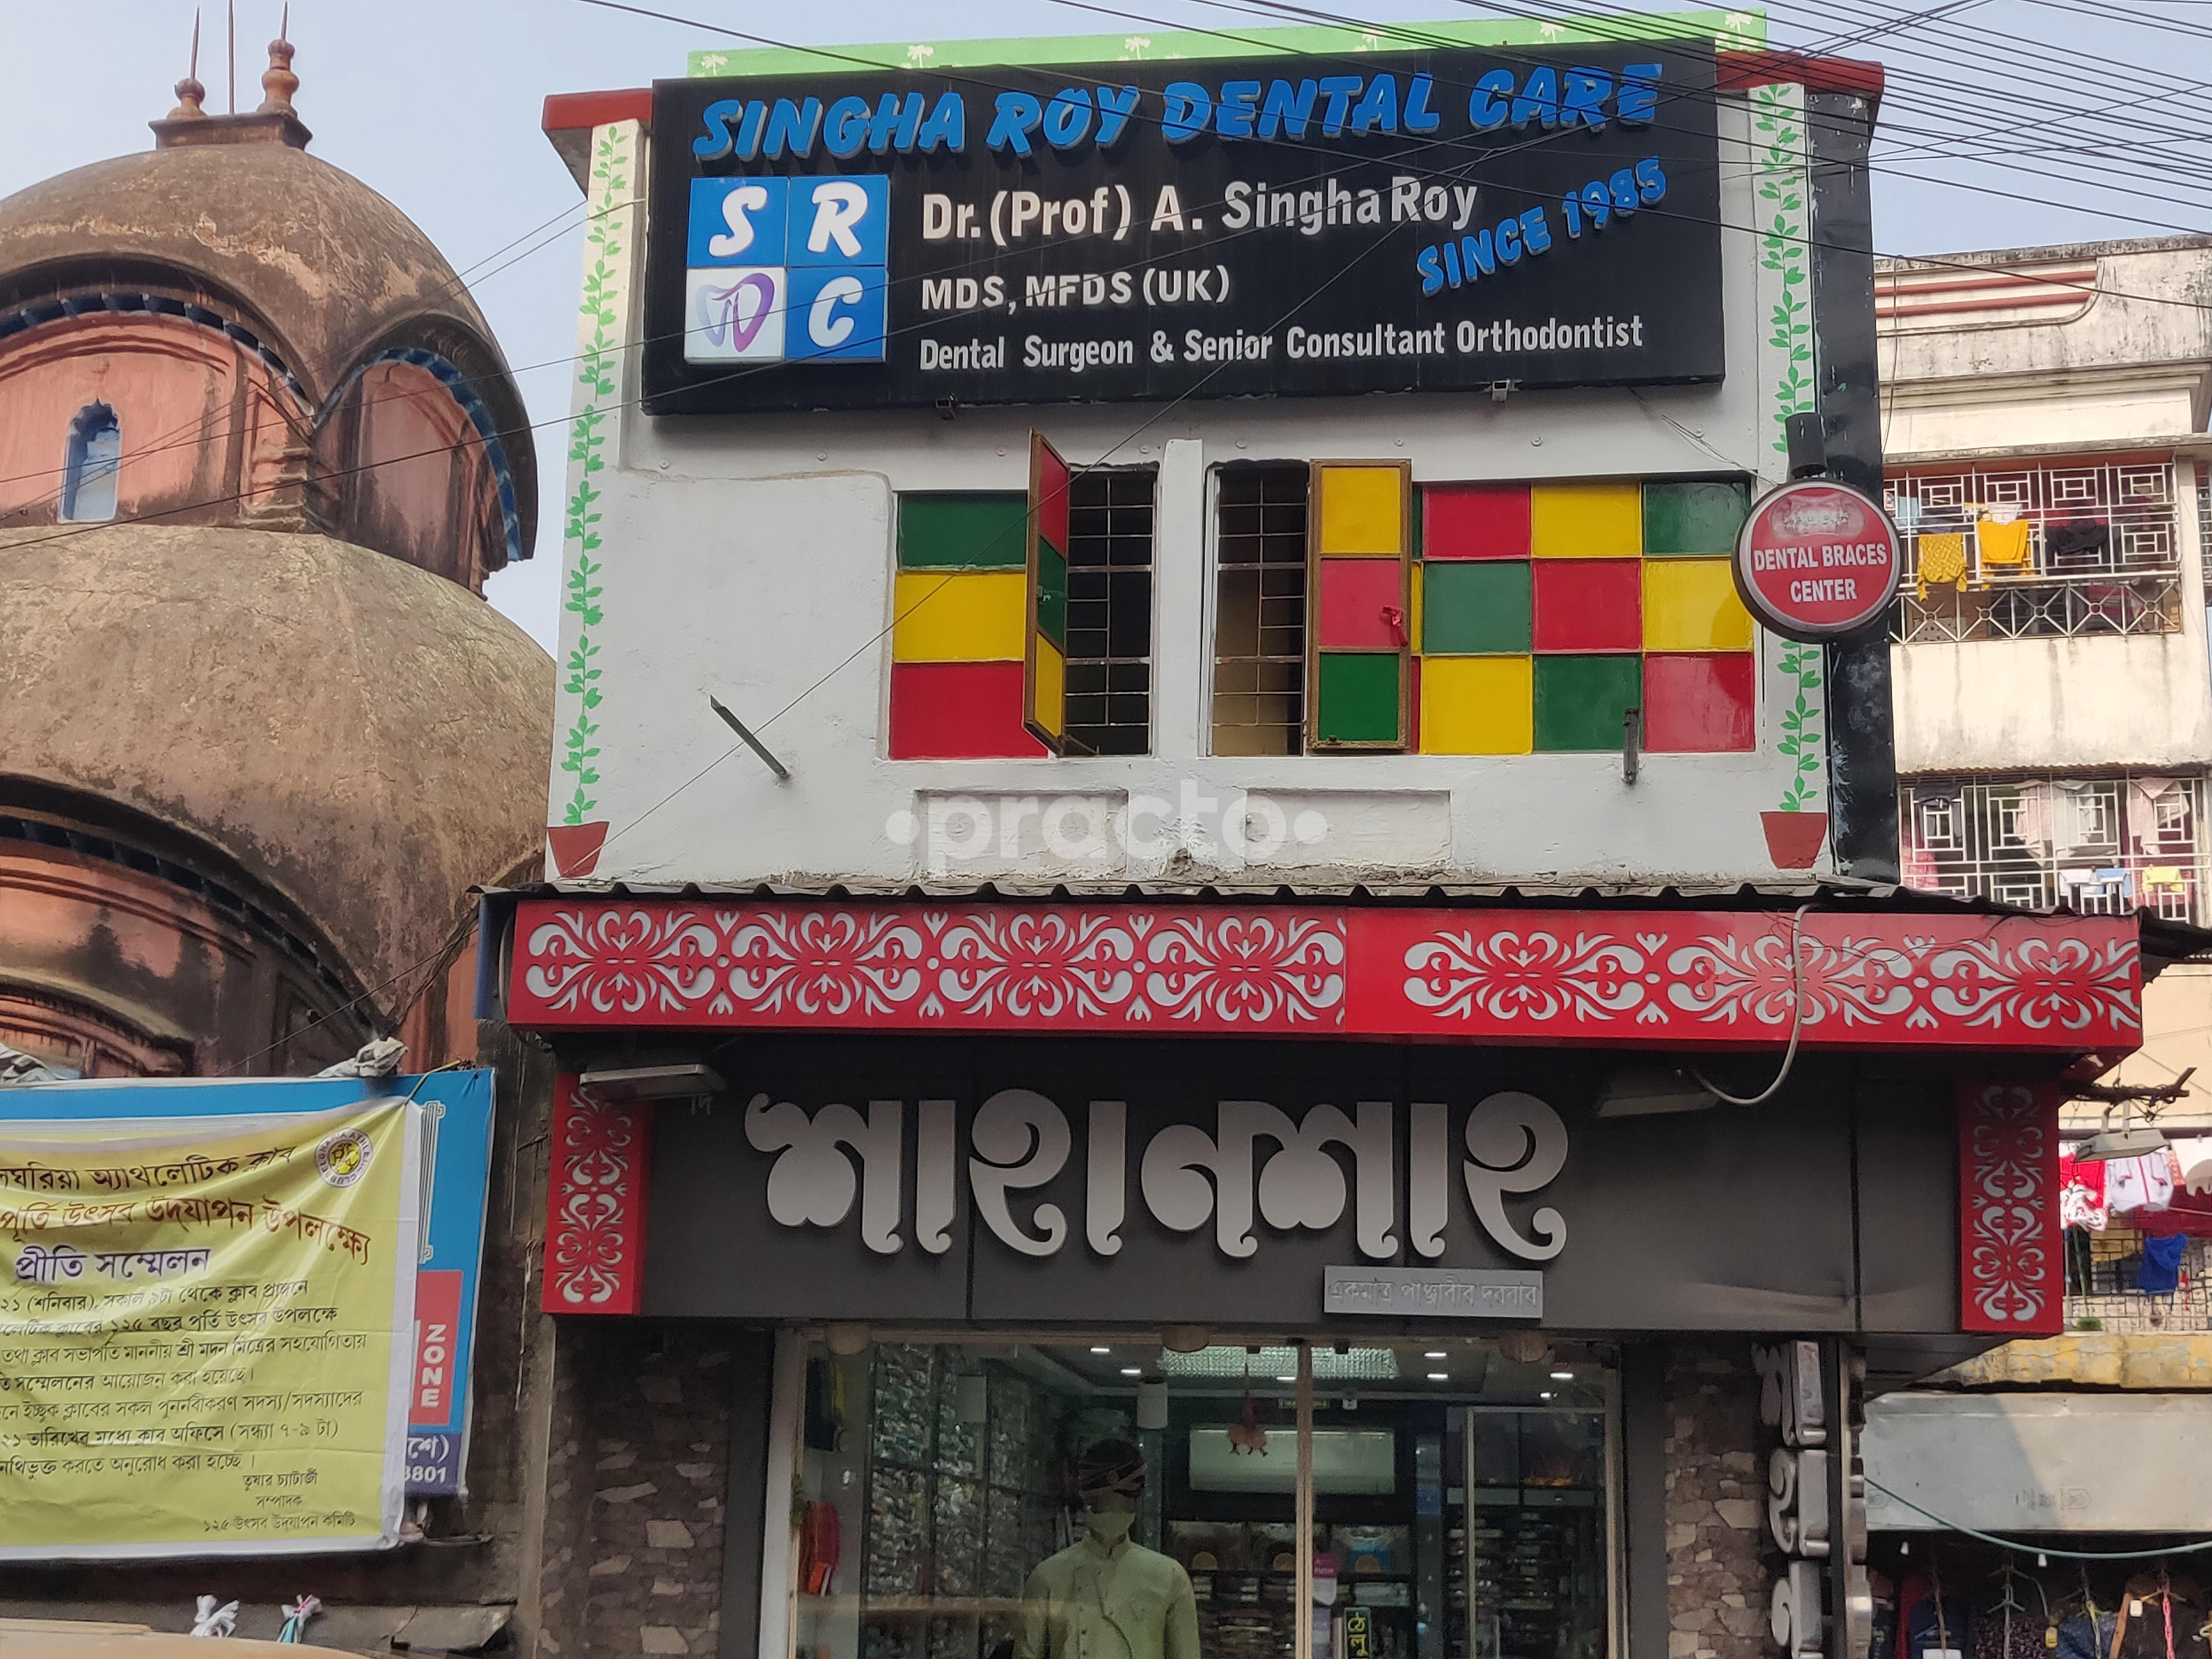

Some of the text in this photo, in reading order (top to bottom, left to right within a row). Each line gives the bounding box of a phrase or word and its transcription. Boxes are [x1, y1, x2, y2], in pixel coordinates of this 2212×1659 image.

[693, 62, 1663, 161] SINGHA ROY DENTAL CARE
[709, 181, 868, 258] S R
[1416, 155, 1668, 298] SINCE 1985
[808, 276, 863, 348] C
[919, 335, 1005, 371] Dental
[1022, 336, 1133, 374] Surgeon
[1182, 326, 1274, 363] Senior
[1285, 322, 1445, 361] Consultant
[1456, 314, 1644, 354] Orthodontist
[1754, 543, 1888, 572] DENTAL BRACES
[1790, 577, 1858, 603] CENTER
[744, 1088, 1570, 1262] শাহানশাহ
[15, 1244, 211, 1283] প্রীতি সম্মেলন
[420, 1323, 447, 1409] ZONE
